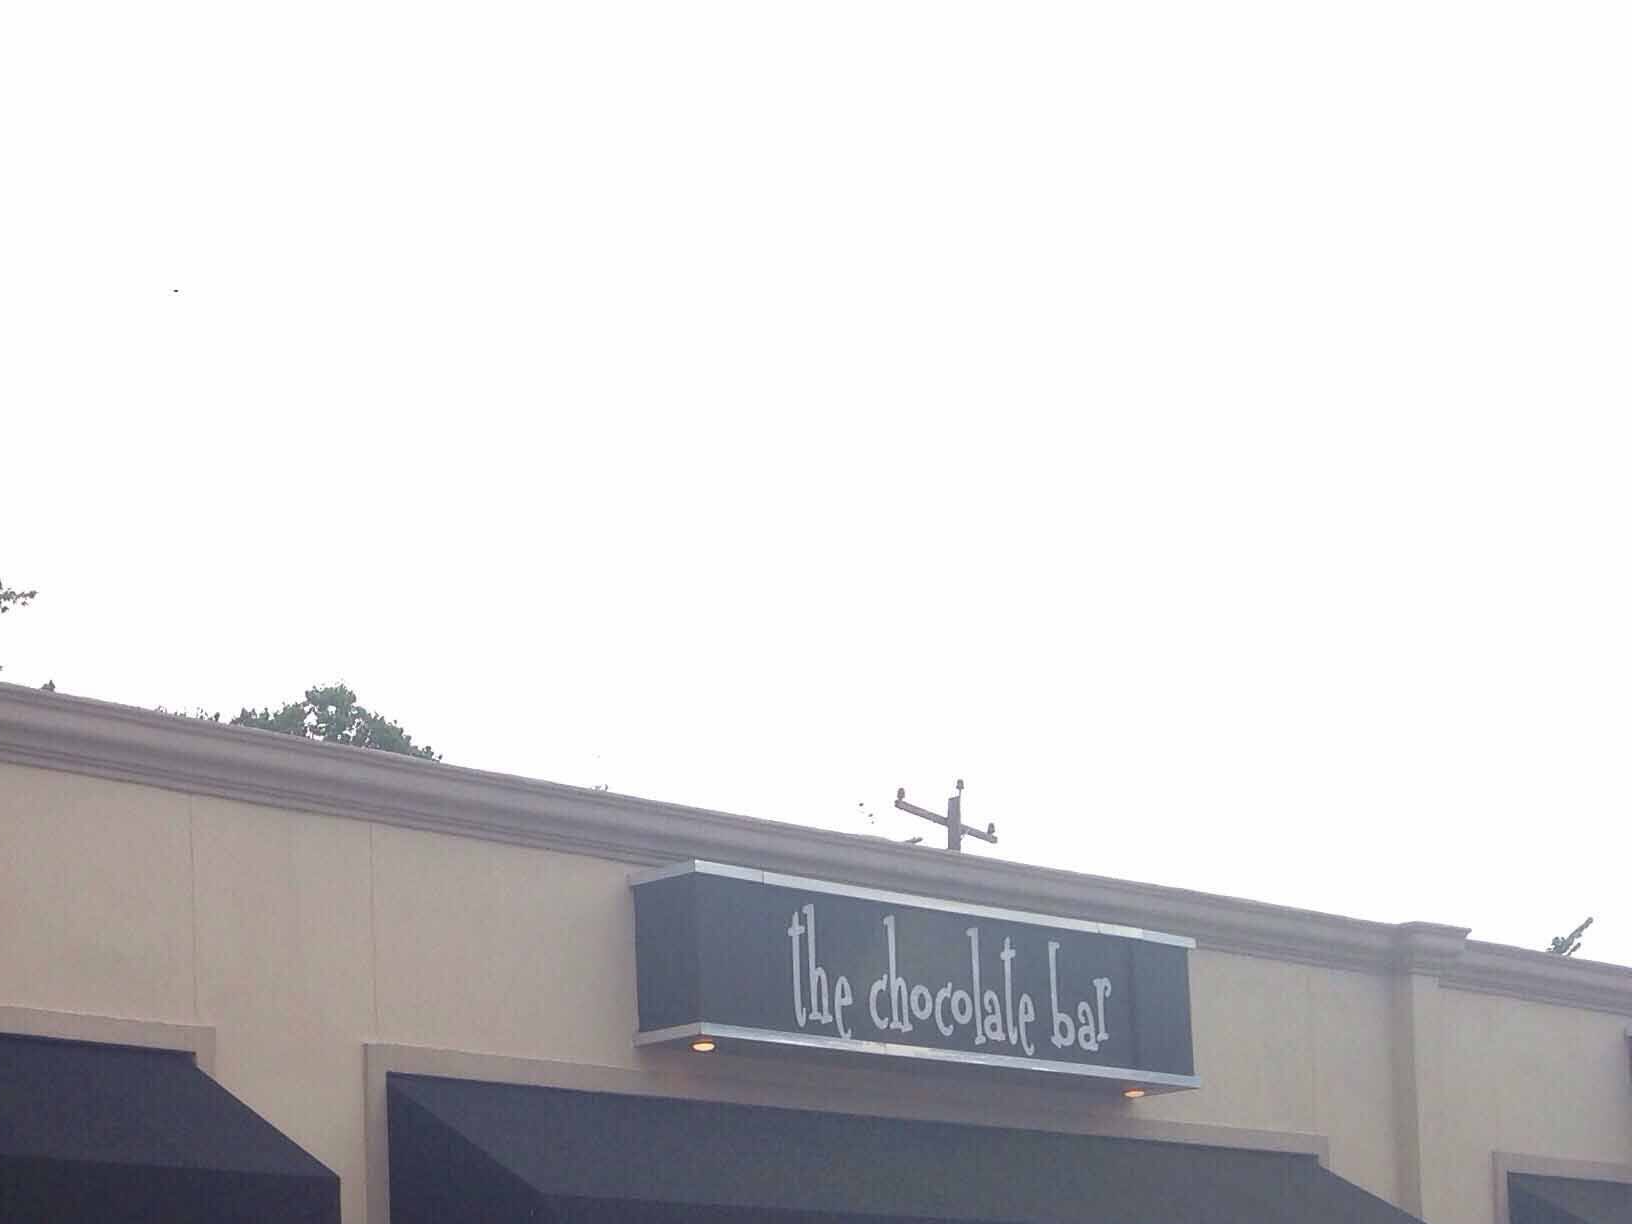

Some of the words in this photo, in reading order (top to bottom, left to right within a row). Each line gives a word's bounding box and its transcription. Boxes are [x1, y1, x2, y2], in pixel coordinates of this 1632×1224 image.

[787, 904, 853, 1038] the
[869, 915, 1034, 1056] chocolate
[1048, 942, 1112, 1052] bar
